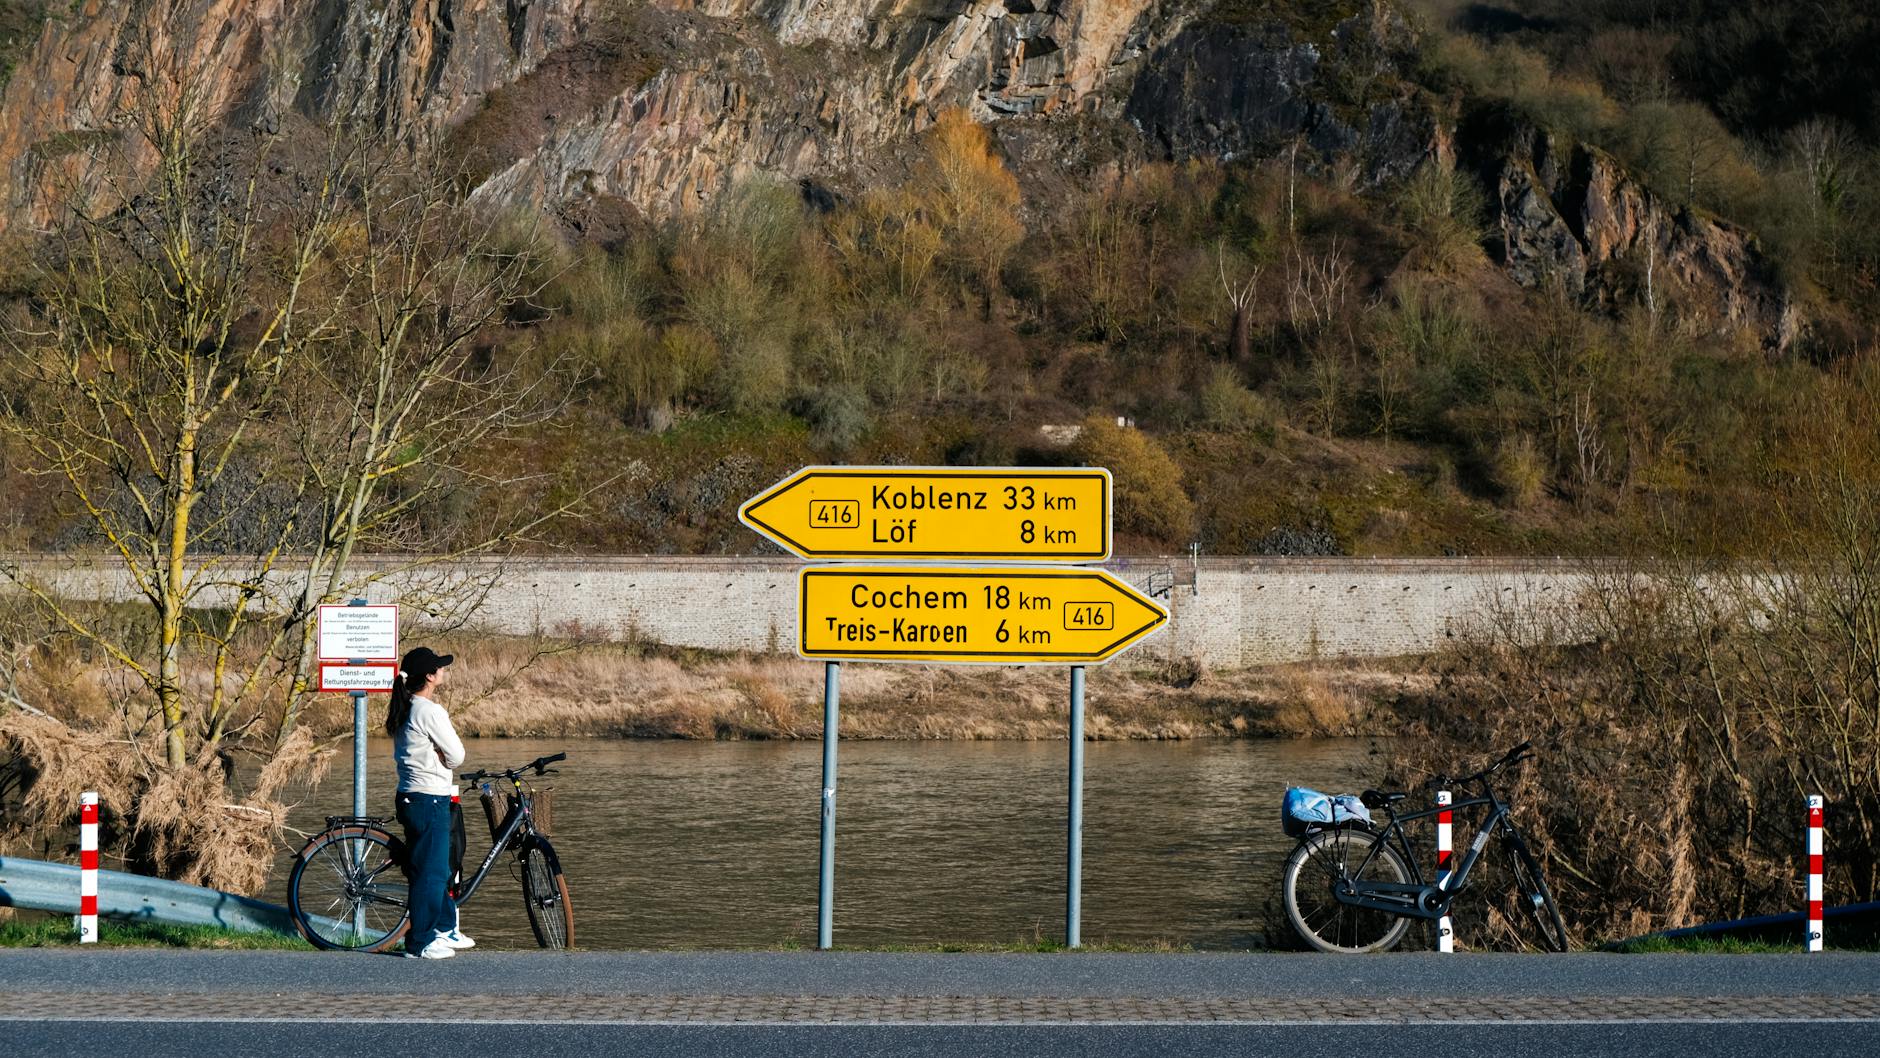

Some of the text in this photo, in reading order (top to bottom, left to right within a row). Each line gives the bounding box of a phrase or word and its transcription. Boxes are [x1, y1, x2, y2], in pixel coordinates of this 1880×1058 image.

[873, 486, 1076, 510] Koblenz 33 km
[817, 505, 852, 524] 416
[872, 519, 1076, 544] Löf 8 km
[851, 584, 1051, 610] Cochem 18 km
[1073, 607, 1104, 626] 416
[996, 619, 1010, 643] 6
[1019, 626, 1051, 644] km
[324, 678, 381, 686] Rettungsfahrzeuge
